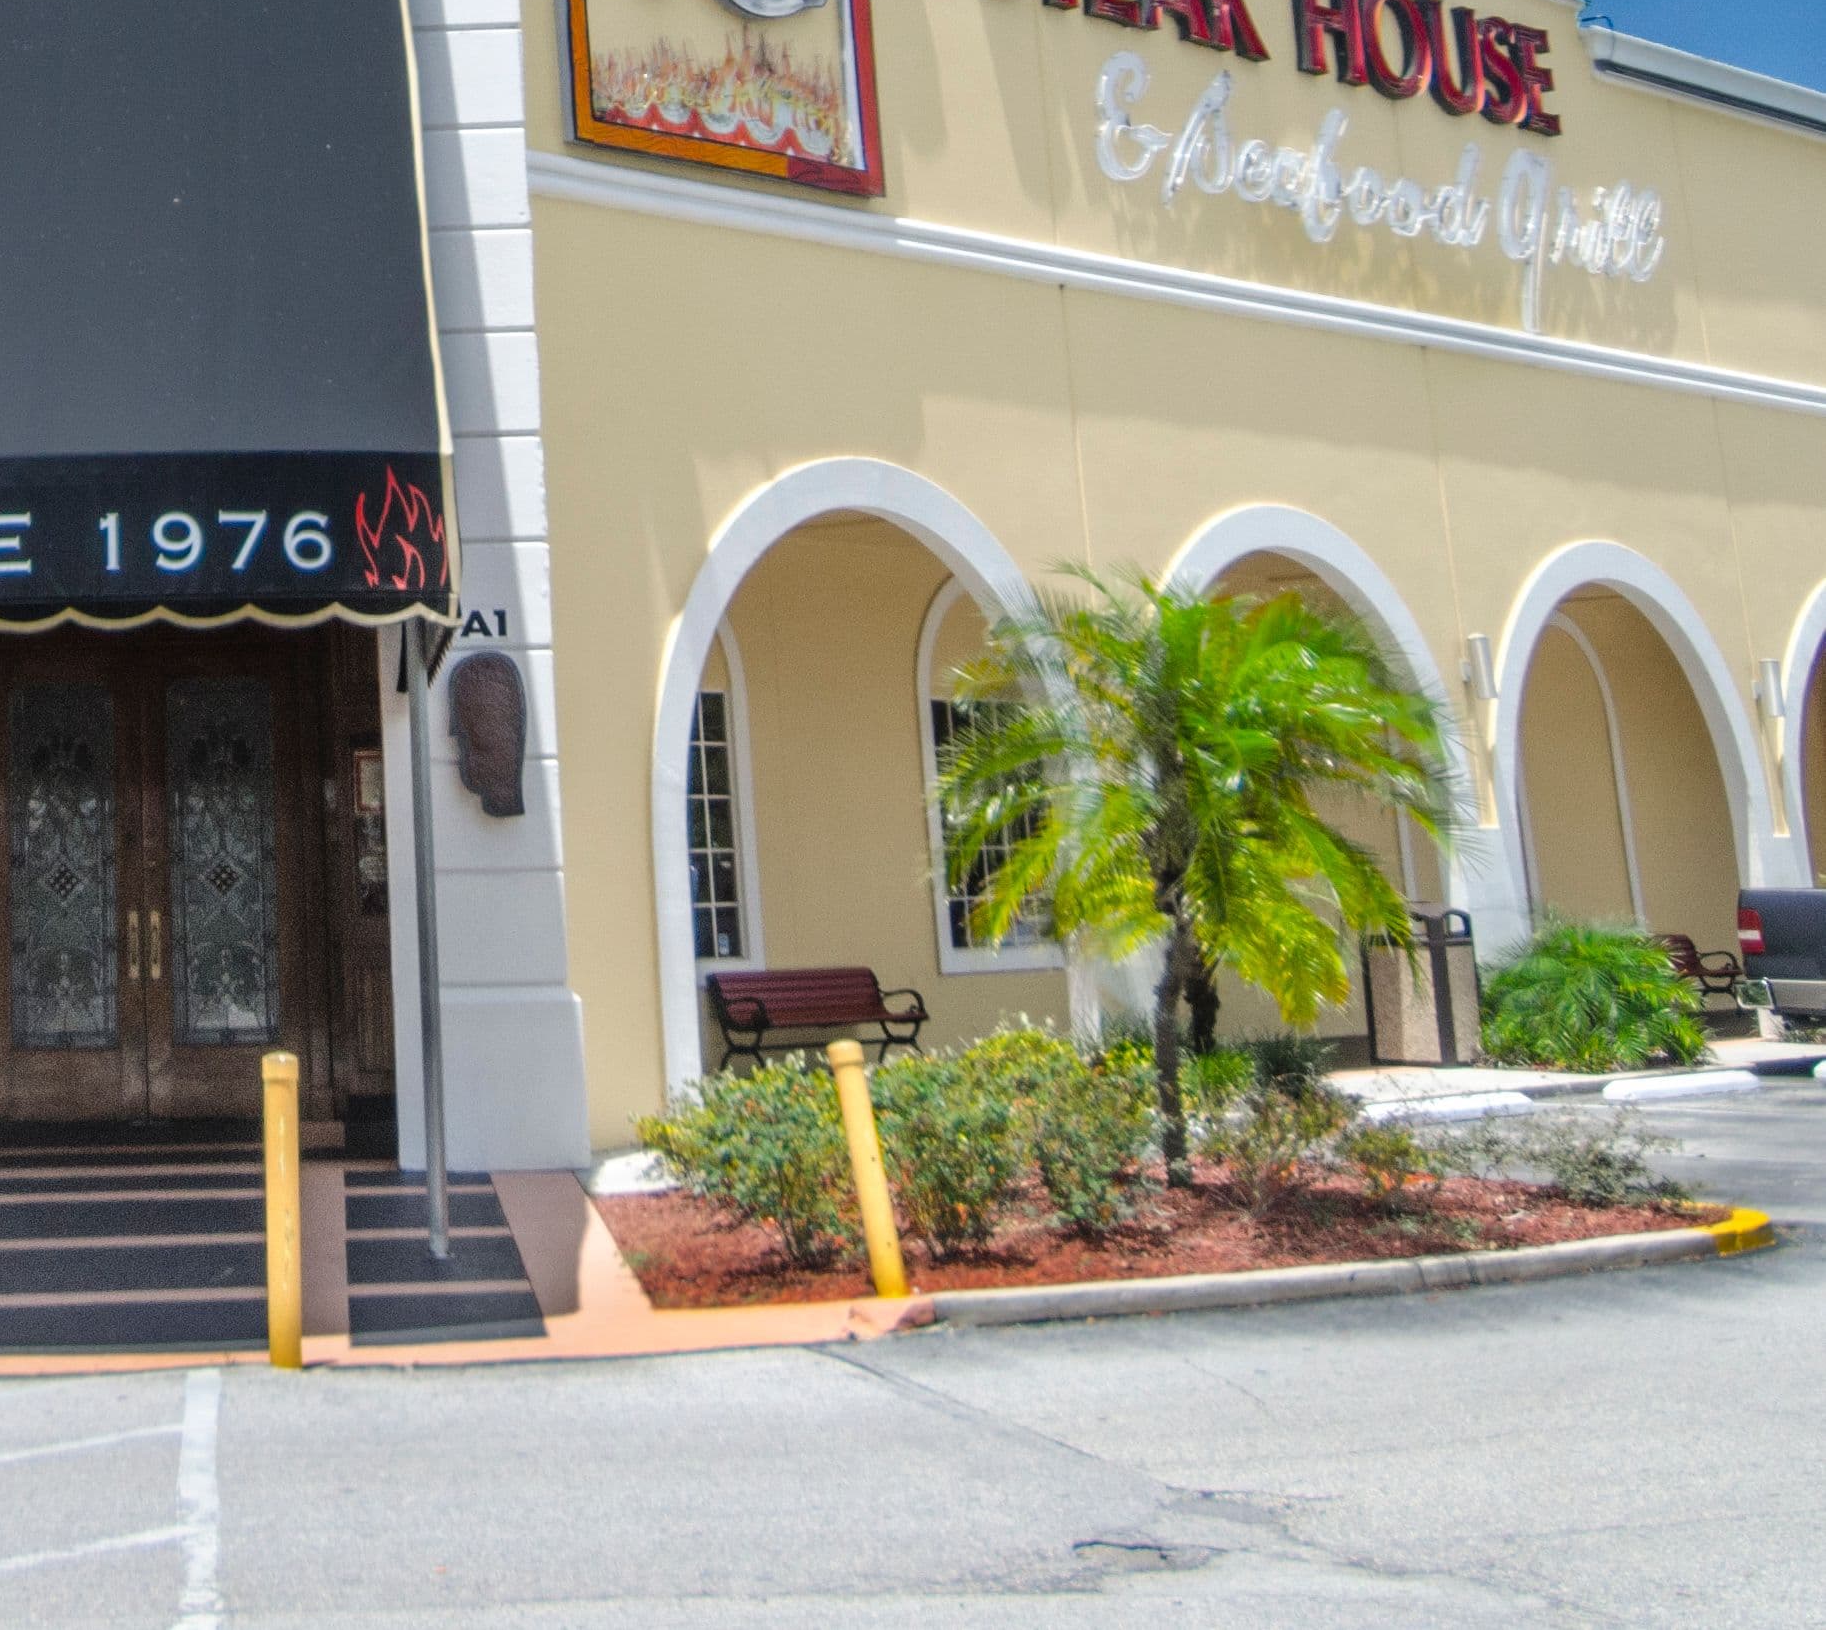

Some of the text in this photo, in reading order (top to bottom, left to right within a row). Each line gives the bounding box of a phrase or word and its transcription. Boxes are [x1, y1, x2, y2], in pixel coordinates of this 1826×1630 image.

[1164, 69, 1491, 242] Seafood
[1500, 148, 1665, 333] Grill
[100, 508, 334, 572] 1976
